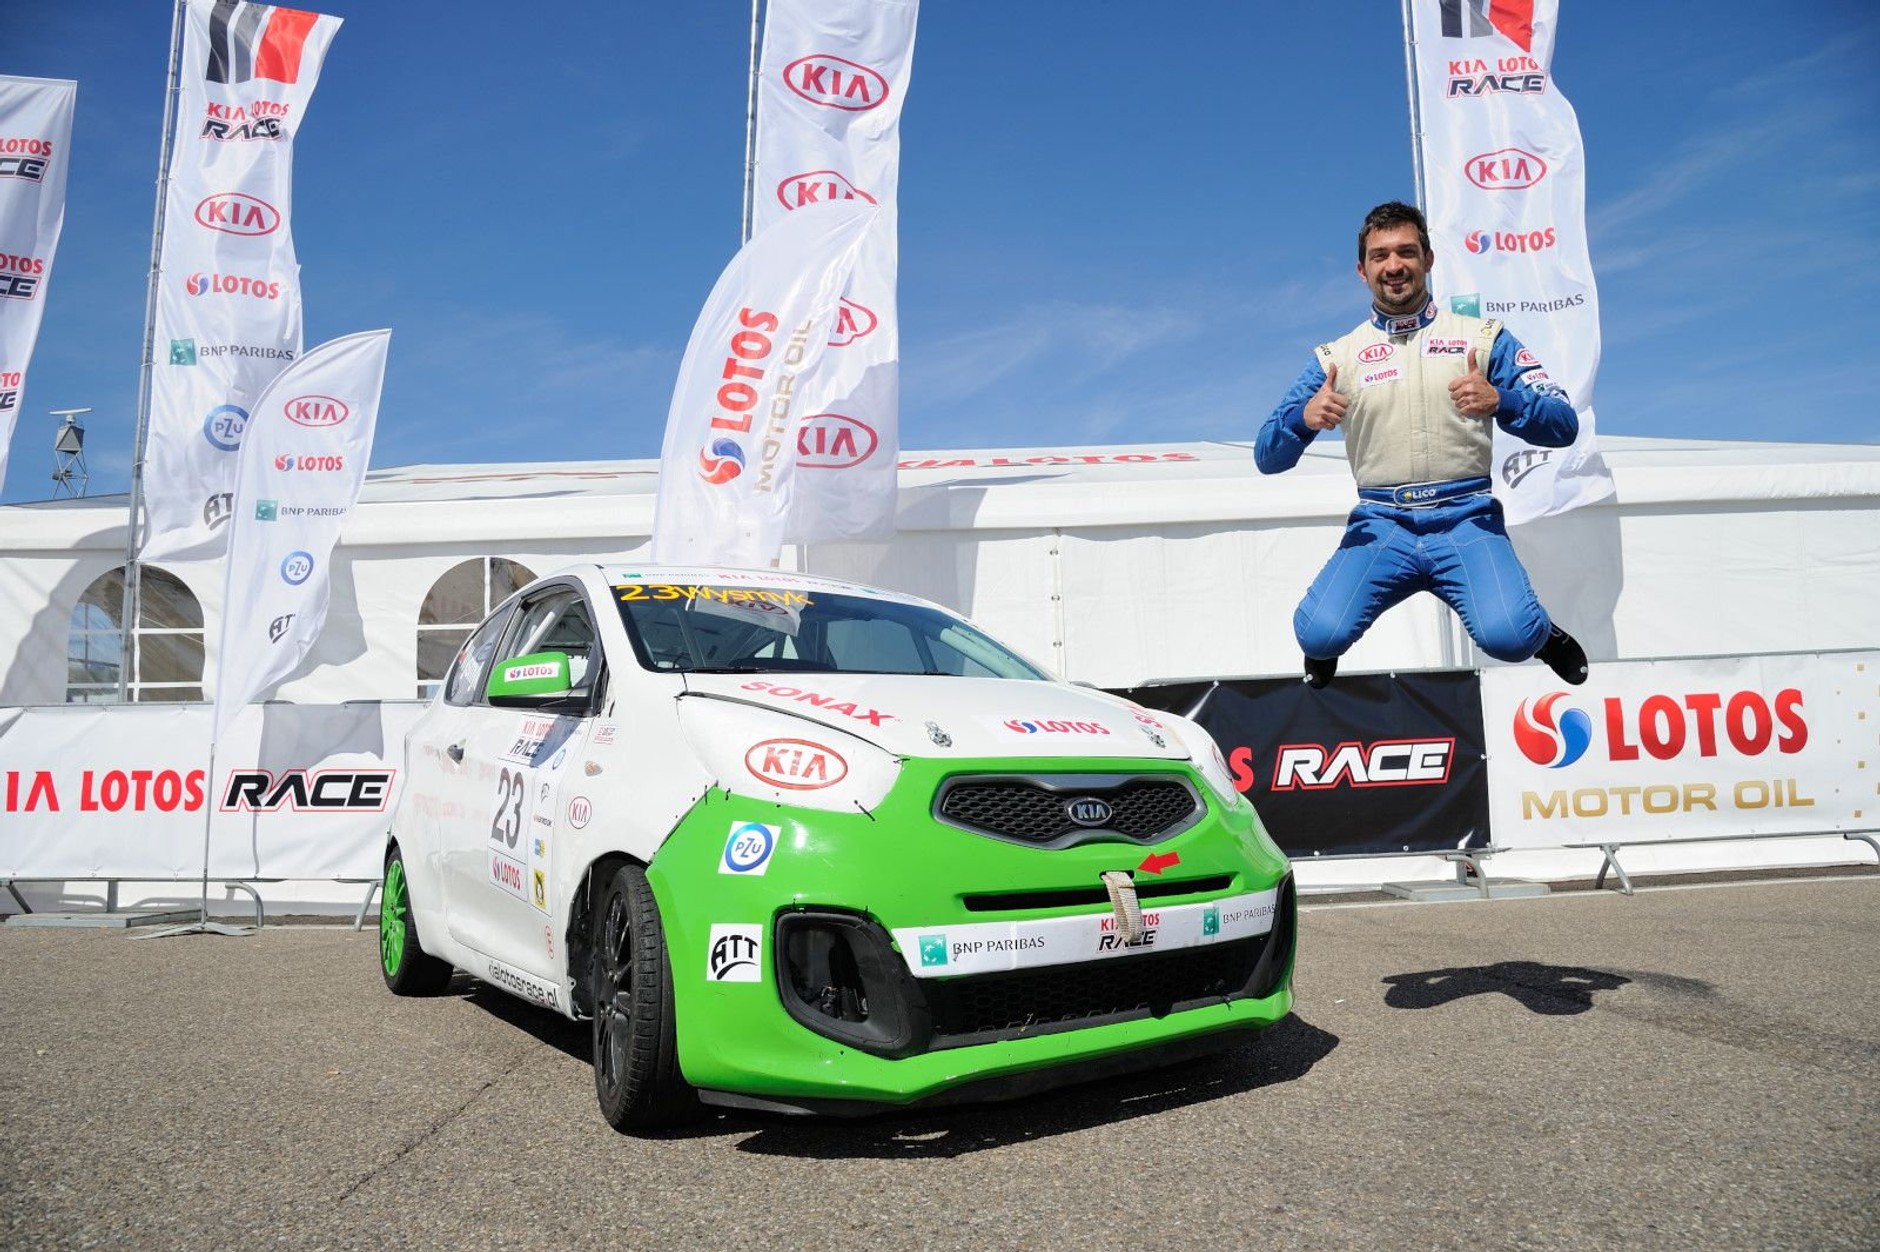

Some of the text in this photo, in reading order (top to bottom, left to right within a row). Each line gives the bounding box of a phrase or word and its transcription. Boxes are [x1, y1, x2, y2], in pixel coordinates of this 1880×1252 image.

[1449, 57, 1540, 75] KIA LOTO
[802, 63, 870, 103] KIA
[1449, 75, 1545, 96] RACE
[206, 102, 246, 120] KIA
[1478, 158, 1531, 182] KIA
[796, 181, 854, 208] KI
[208, 201, 266, 230] KIA
[1495, 227, 1556, 253] LOTOS
[213, 273, 280, 300] LOTOS
[1486, 294, 1585, 313] BNP PARIBAS
[200, 346, 294, 361] BNP PARIBAS
[1365, 346, 1388, 361] KIA
[710, 307, 779, 433] LOTOS
[1374, 368, 1398, 381] LOTOS
[295, 402, 338, 421] KIA
[753, 319, 813, 492] MOTOR OIL
[297, 456, 343, 471] LOTOS
[1502, 449, 1553, 486] ATT
[1412, 488, 1437, 500] LICO
[203, 492, 234, 526] AT
[281, 507, 347, 517] BNP PARIBA
[269, 613, 297, 641] AT
[522, 666, 554, 678] LOTOS
[740, 681, 895, 728] SONAX
[1033, 720, 1110, 735] LOTOS
[1606, 688, 1808, 762] LOTOS
[762, 747, 827, 780] KIA
[1278, 745, 1450, 782] RACE
[7, 770, 205, 812] IA LOTOS
[226, 774, 389, 807] RACE
[1522, 779, 1815, 820] MOTOR OIL
[491, 767, 524, 850] 23
[571, 802, 589, 823] KIA
[1076, 804, 1107, 819] KIA
[735, 837, 762, 859] PZU
[501, 861, 521, 891] LOTOS
[1223, 911, 1241, 924] BNP
[711, 934, 759, 976] ATT
[953, 935, 1045, 955] BNP PARIBAS
